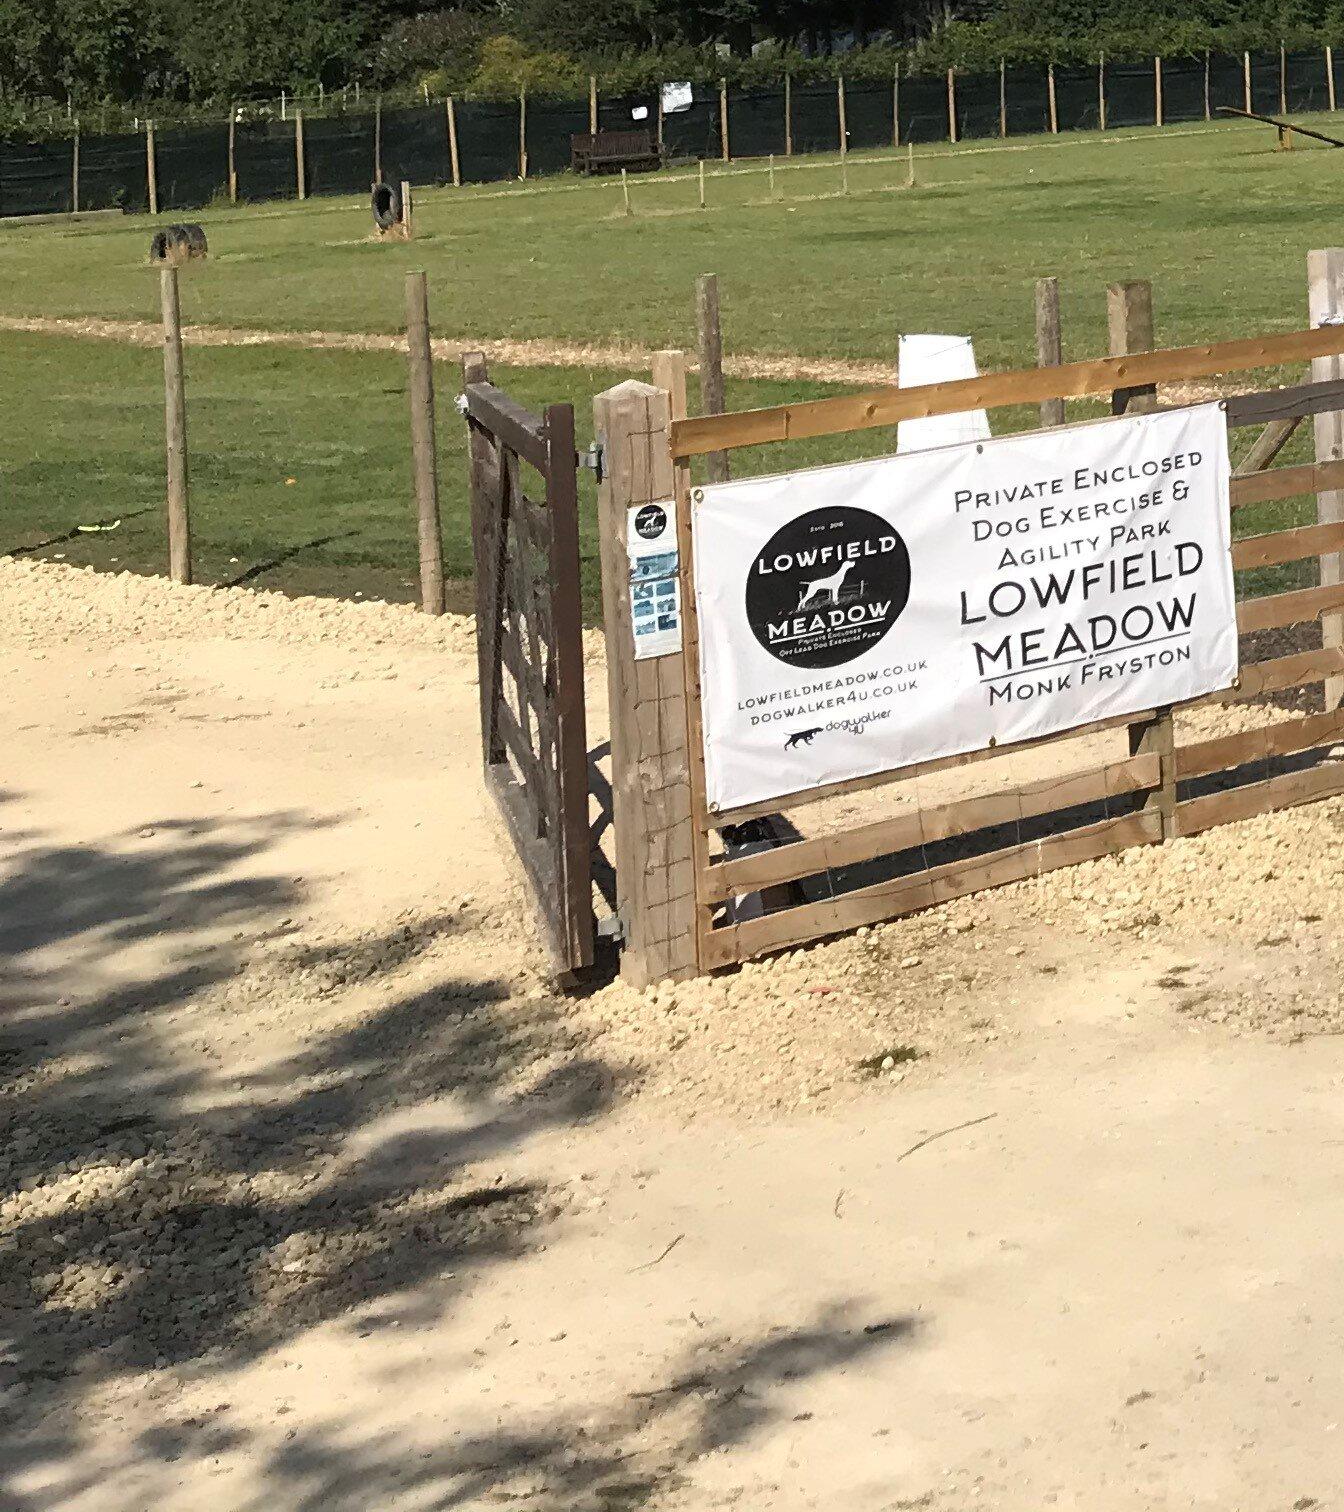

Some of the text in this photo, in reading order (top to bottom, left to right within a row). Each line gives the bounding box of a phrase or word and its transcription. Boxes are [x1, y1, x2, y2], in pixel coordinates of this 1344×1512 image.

[954, 451, 1202, 513] PRIVATE ENCLOSED
[972, 480, 1190, 542] DOG EXERCISE &
[758, 536, 896, 575] LOWFIELD
[997, 520, 1171, 570] AGILITY PARK
[960, 541, 1203, 625] LOWFIELD
[767, 600, 891, 640] MEADOW
[972, 592, 1197, 677] MEADOW
[738, 660, 929, 711] LOWFIELDMEADOW.CO.UK
[989, 645, 1190, 707] MONK FRYSTON
[751, 680, 918, 726] DOGWALKER4U.CO.UK
[825, 709, 892, 732] dogwalker
